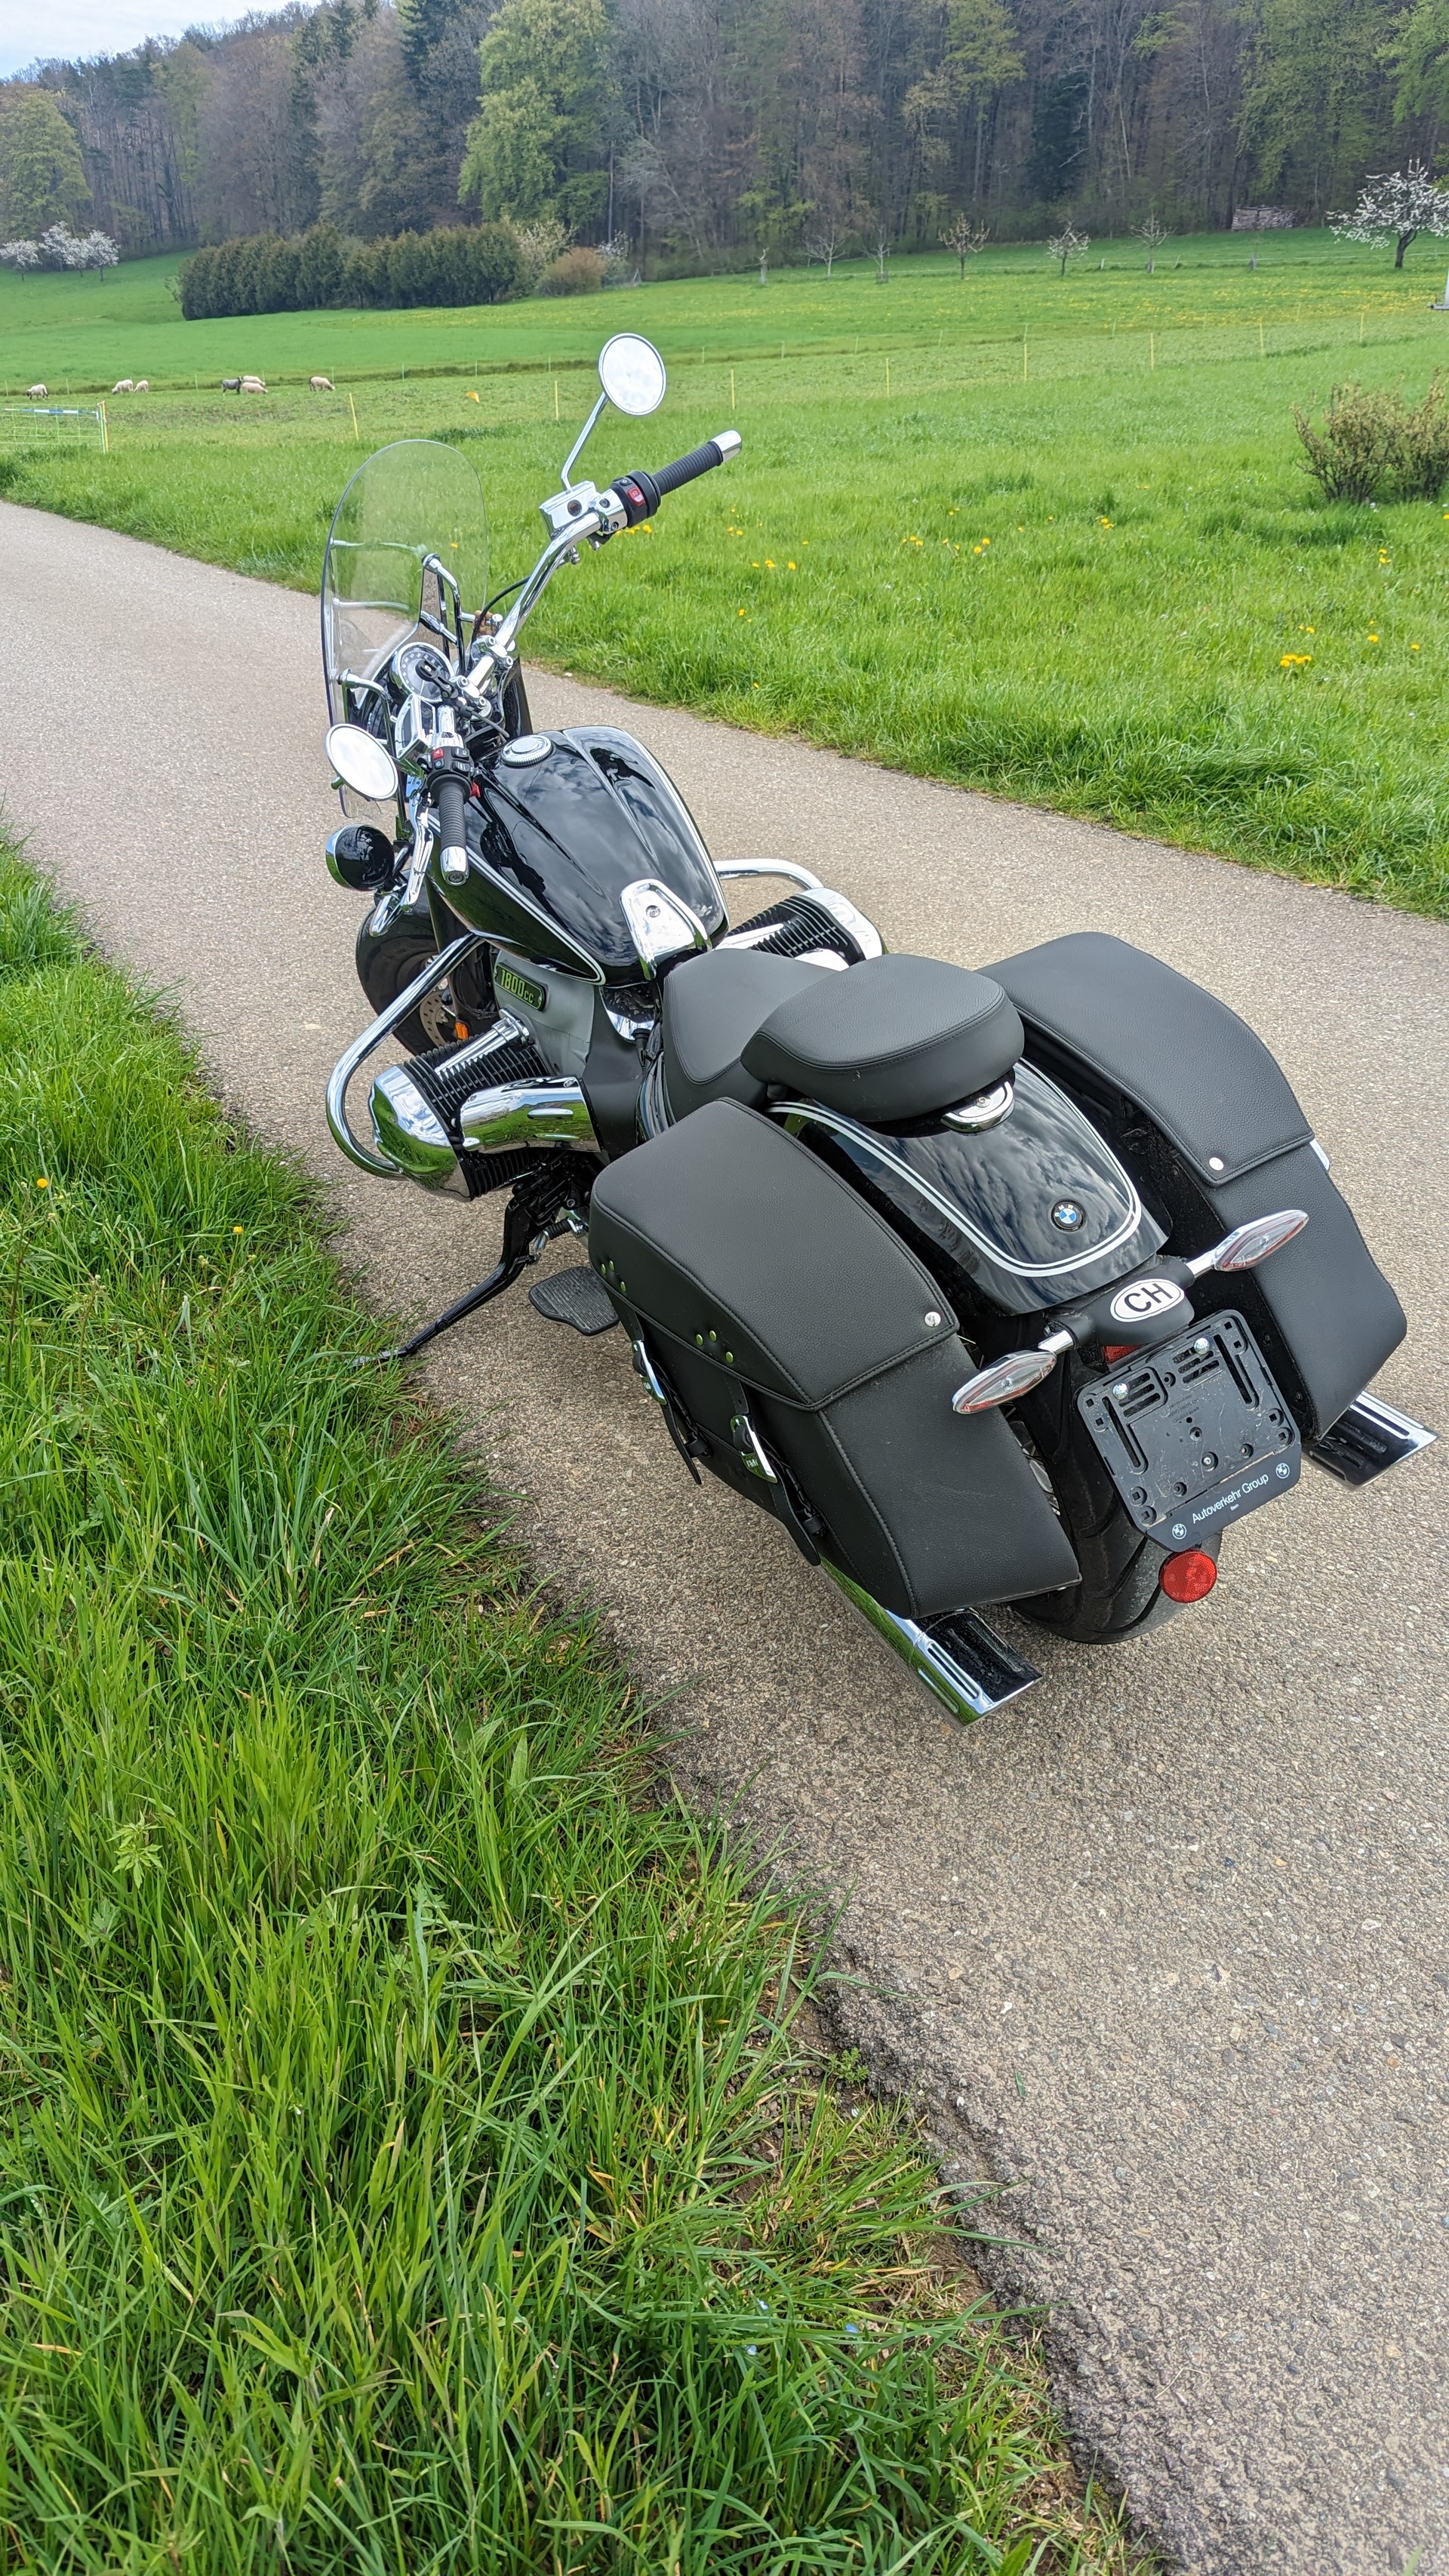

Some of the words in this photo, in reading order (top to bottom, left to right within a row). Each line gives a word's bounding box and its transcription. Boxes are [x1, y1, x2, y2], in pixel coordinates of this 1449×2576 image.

[1124, 1282, 1174, 1313] CH
[1192, 1488, 1241, 1524] Autoverkehr
[1241, 1474, 1269, 1494] Group
